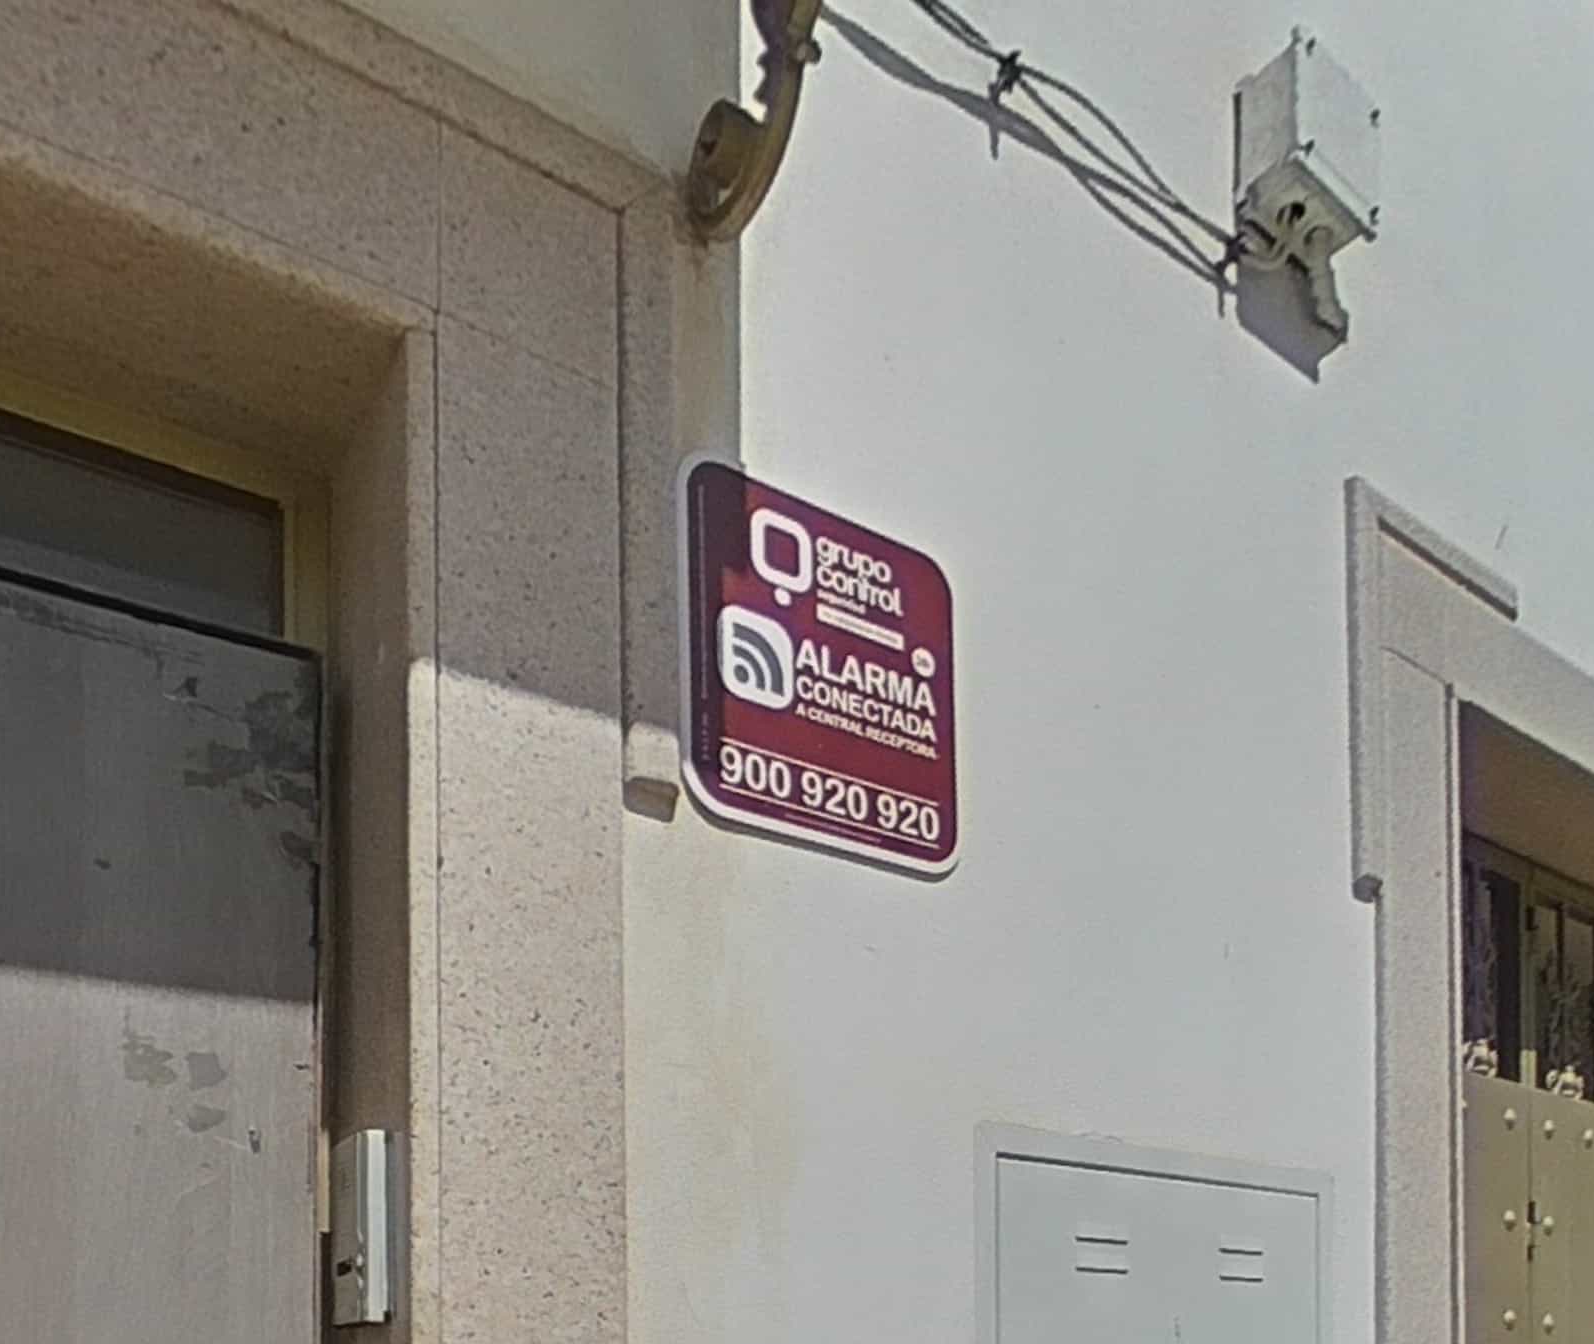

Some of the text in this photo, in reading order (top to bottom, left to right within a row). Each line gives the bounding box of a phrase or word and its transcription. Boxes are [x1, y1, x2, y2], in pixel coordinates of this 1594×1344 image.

[816, 536, 892, 583] grupo
[816, 565, 904, 617] control
[796, 639, 937, 717] ALARMA
[796, 675, 938, 743] CONECTADA
[795, 702, 939, 760] A CENTRAL RECEPTORA
[719, 744, 792, 799] 900
[801, 770, 869, 822] 920
[876, 794, 941, 841] 920
